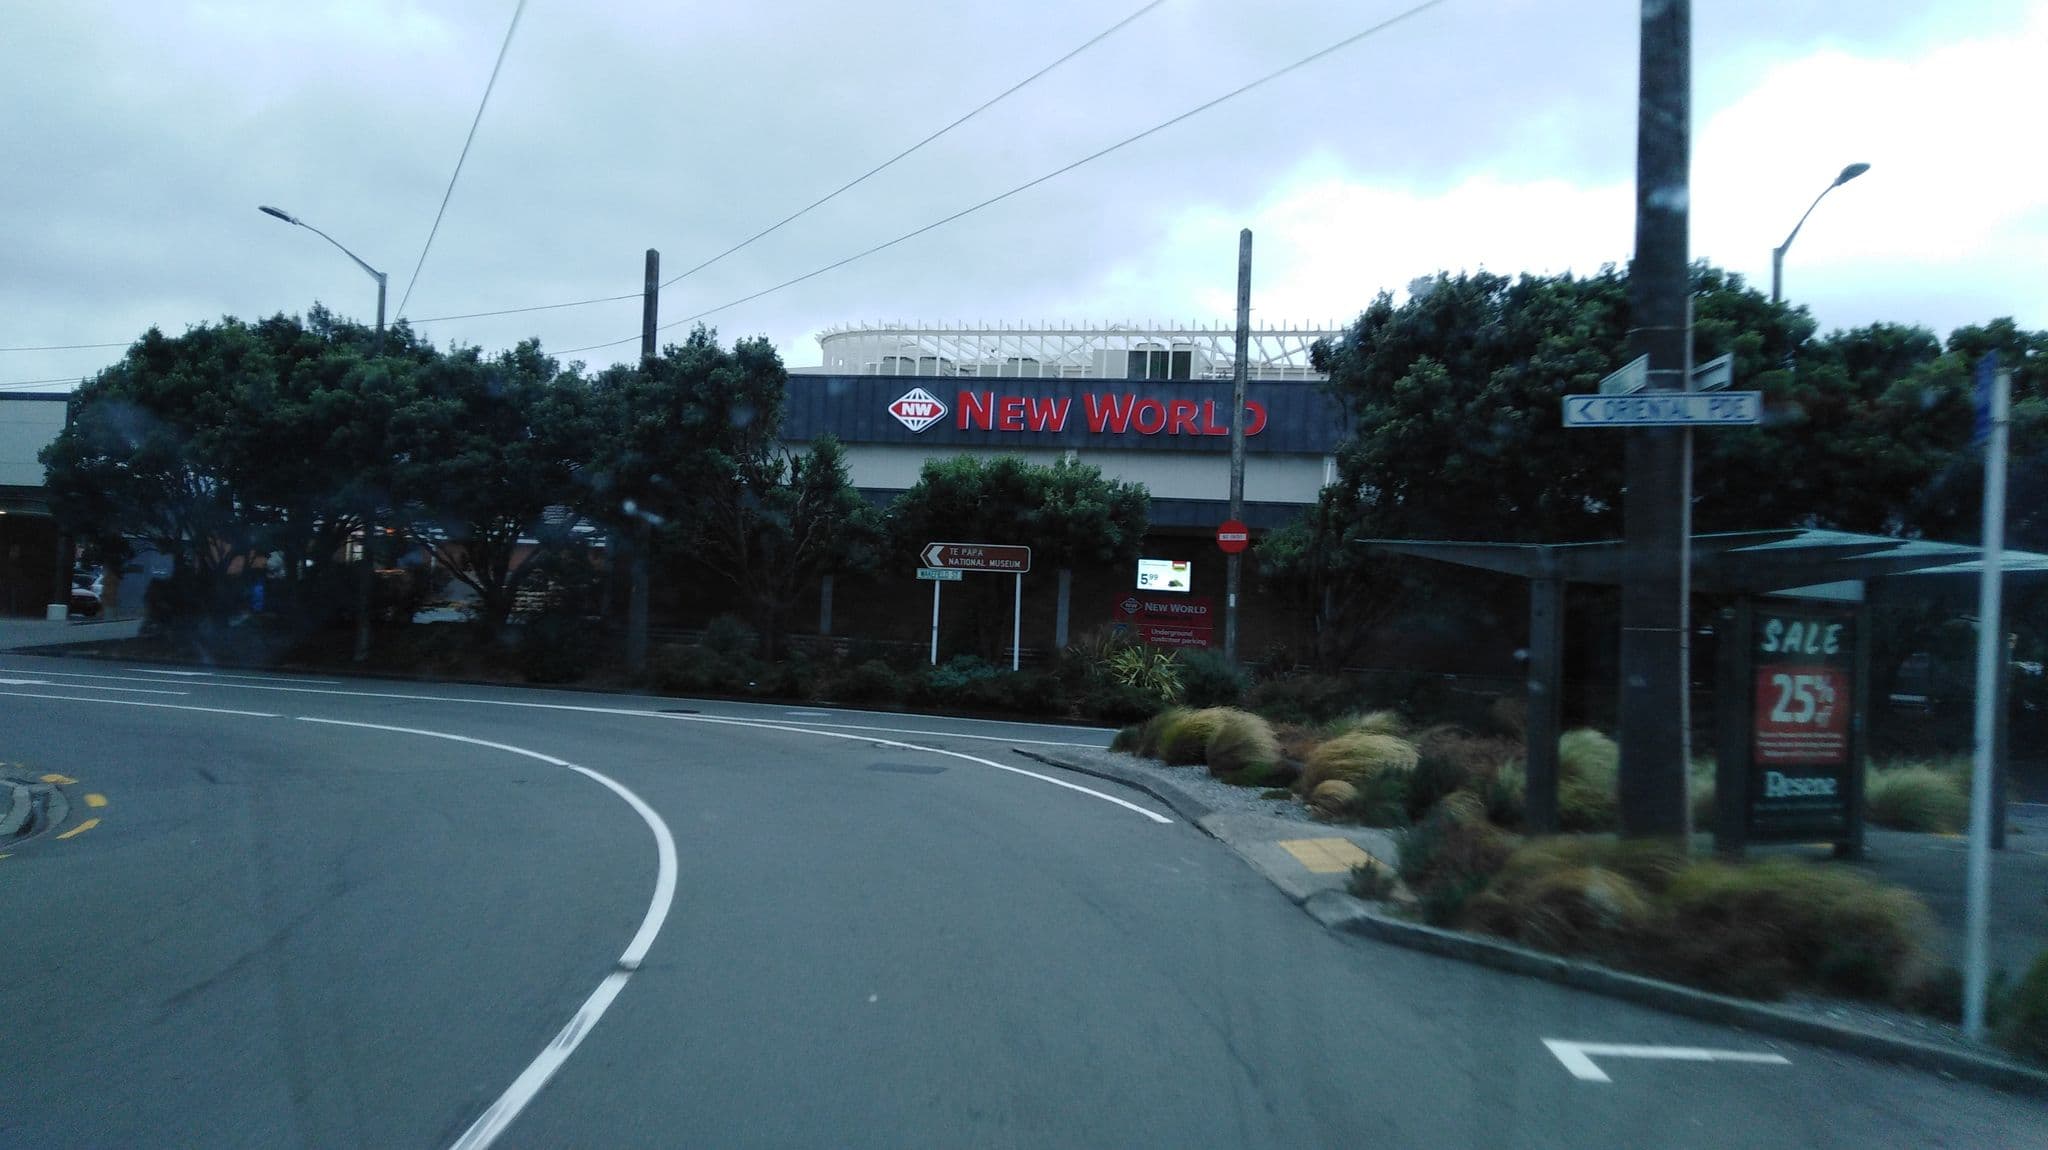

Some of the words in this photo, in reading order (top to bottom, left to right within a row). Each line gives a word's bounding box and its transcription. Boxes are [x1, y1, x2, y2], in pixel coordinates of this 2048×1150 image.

[900, 403, 933, 417] NW
[957, 391, 1071, 432] NEW
[1083, 393, 1268, 436] WORLD
[949, 547, 959, 556] TE
[961, 548, 984, 557] PAPA
[948, 558, 985, 567] NATIONAL
[989, 559, 1021, 568] MUSEUM
[1144, 602, 1168, 613] NEW
[1170, 603, 1207, 614] WORLD
[1151, 628, 1193, 638] Underground
[1762, 619, 1843, 655] SALE
[1182, 638, 1207, 646] parking
